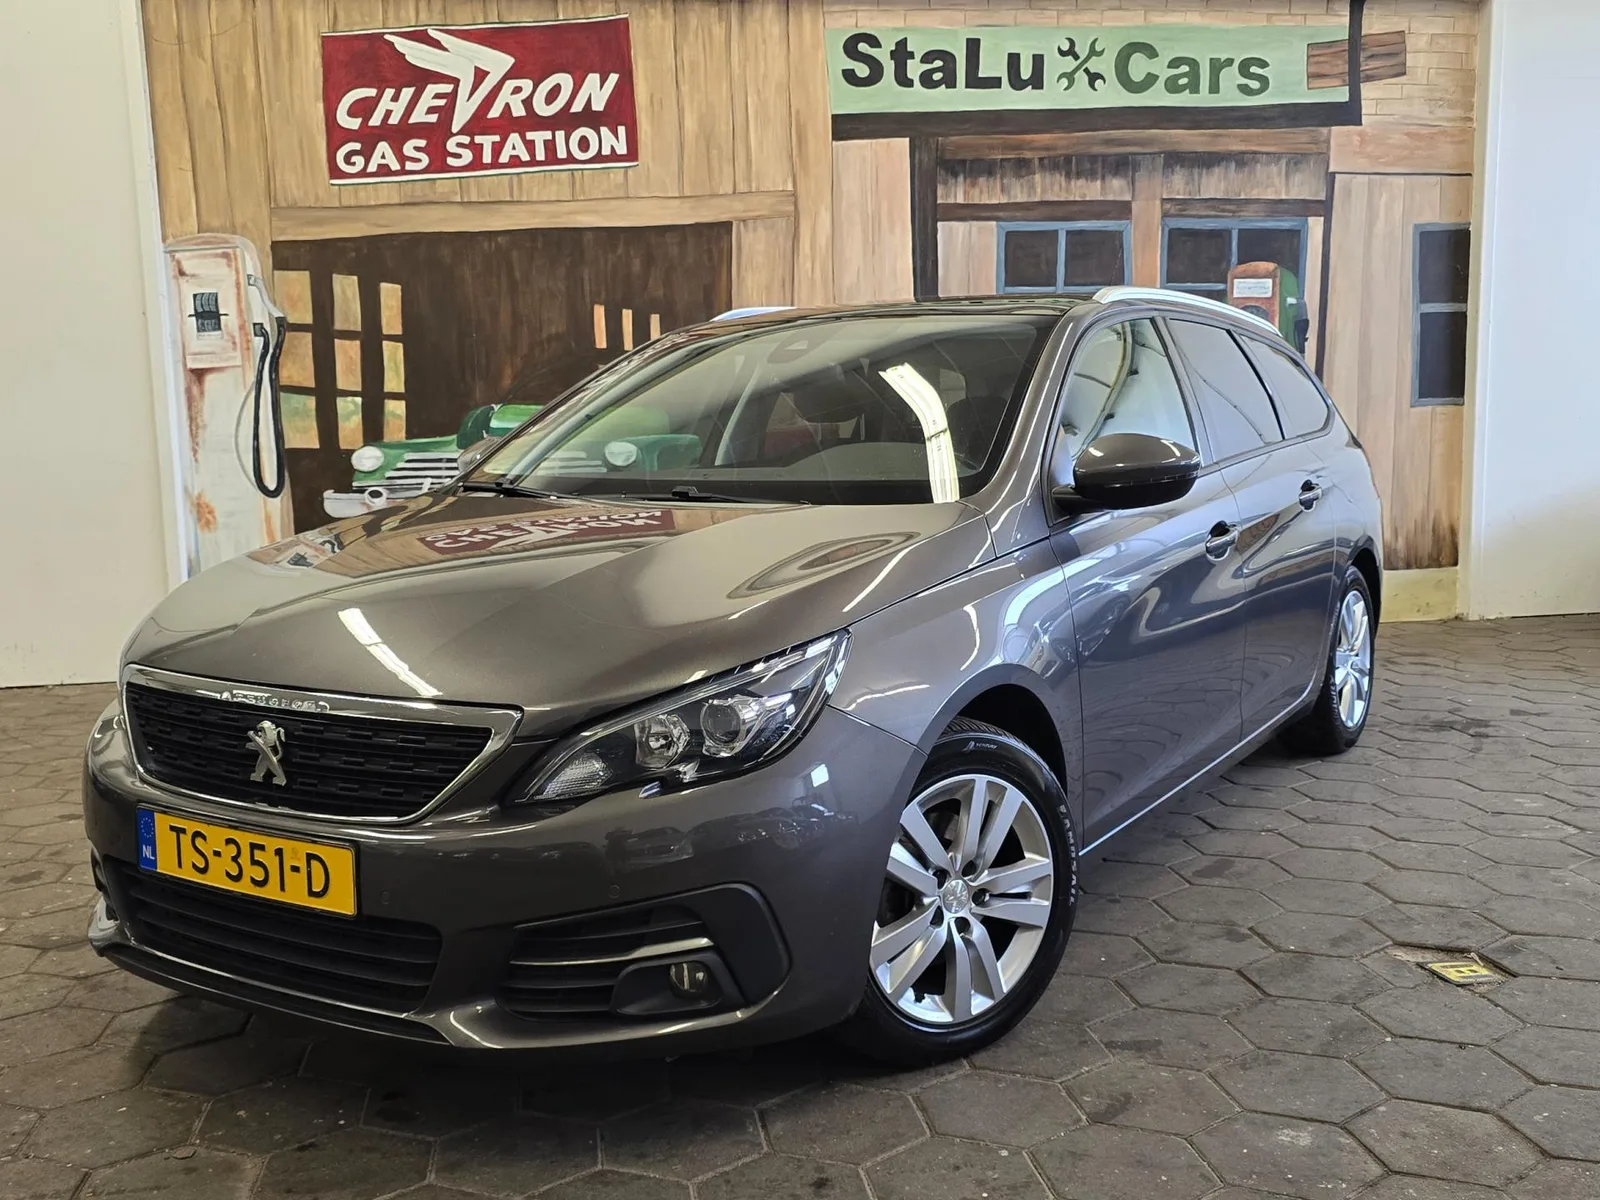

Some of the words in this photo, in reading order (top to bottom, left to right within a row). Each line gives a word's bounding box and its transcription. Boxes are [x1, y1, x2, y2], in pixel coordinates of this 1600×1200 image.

[335, 60, 620, 134] CHEVRON
[841, 32, 1045, 91] StaLu
[1113, 41, 1271, 97] Cars
[335, 139, 430, 173] GAS
[445, 125, 628, 168] STATION
[142, 844, 156, 861] NL
[168, 824, 331, 899] TS-351-D
